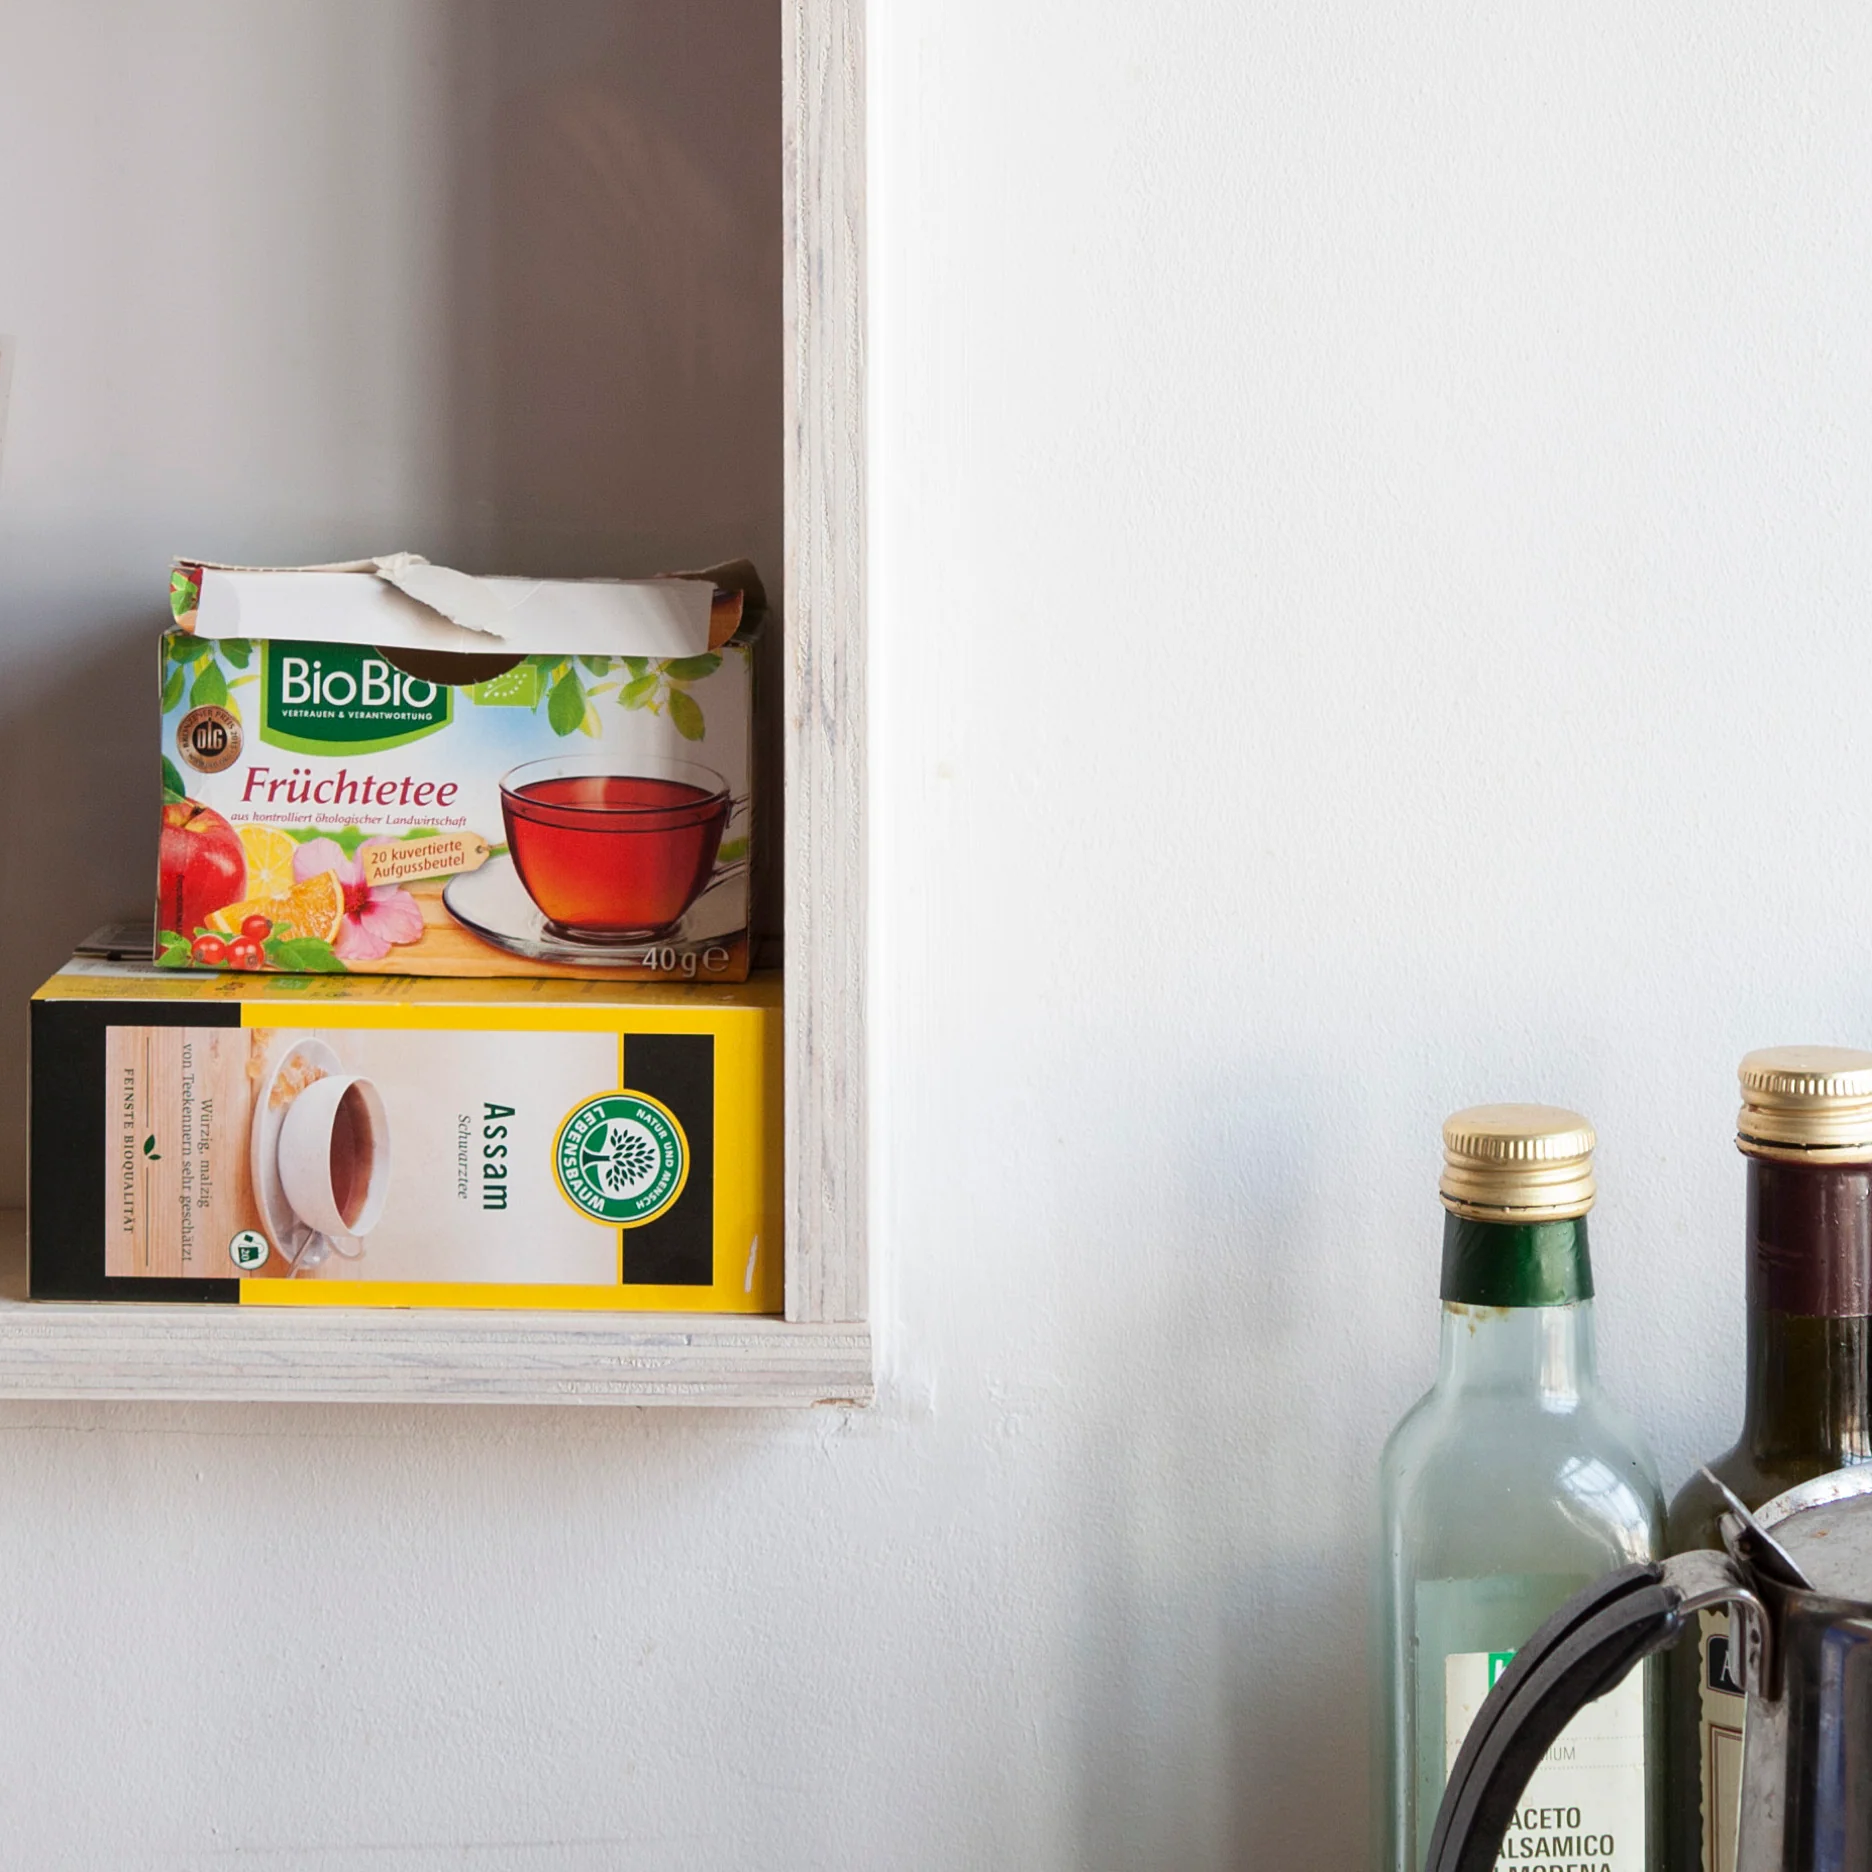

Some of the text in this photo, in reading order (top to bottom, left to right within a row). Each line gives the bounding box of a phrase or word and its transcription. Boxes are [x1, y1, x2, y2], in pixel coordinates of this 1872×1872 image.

[281, 657, 438, 709] BioBio
[197, 720, 223, 749] DLG
[282, 709, 433, 721] VERTRAUEN & VERANTWORTUNG
[240, 766, 458, 808] Früchtetee
[230, 811, 467, 828] aus kontrolliert ökologischer Landwirtschaft
[371, 840, 462, 865] 20 kuvertierte
[373, 851, 465, 880] Aufgussbeutel
[121, 1068, 135, 1234] FEINSTE BIOQUALITÄT
[178, 1043, 196, 1262] von Teekennern sehr geschätzt
[196, 1098, 212, 1208] Würzig, malzig
[456, 1114, 470, 1200] Schwarztee
[482, 1102, 514, 1211] Assam
[562, 1105, 605, 1212] LEBENSBAUM
[634, 1108, 673, 1210] NATUR UND MENSCH
[239, 1248, 250, 1261] 20
[1495, 1833, 1615, 1860] ALSAMICO
